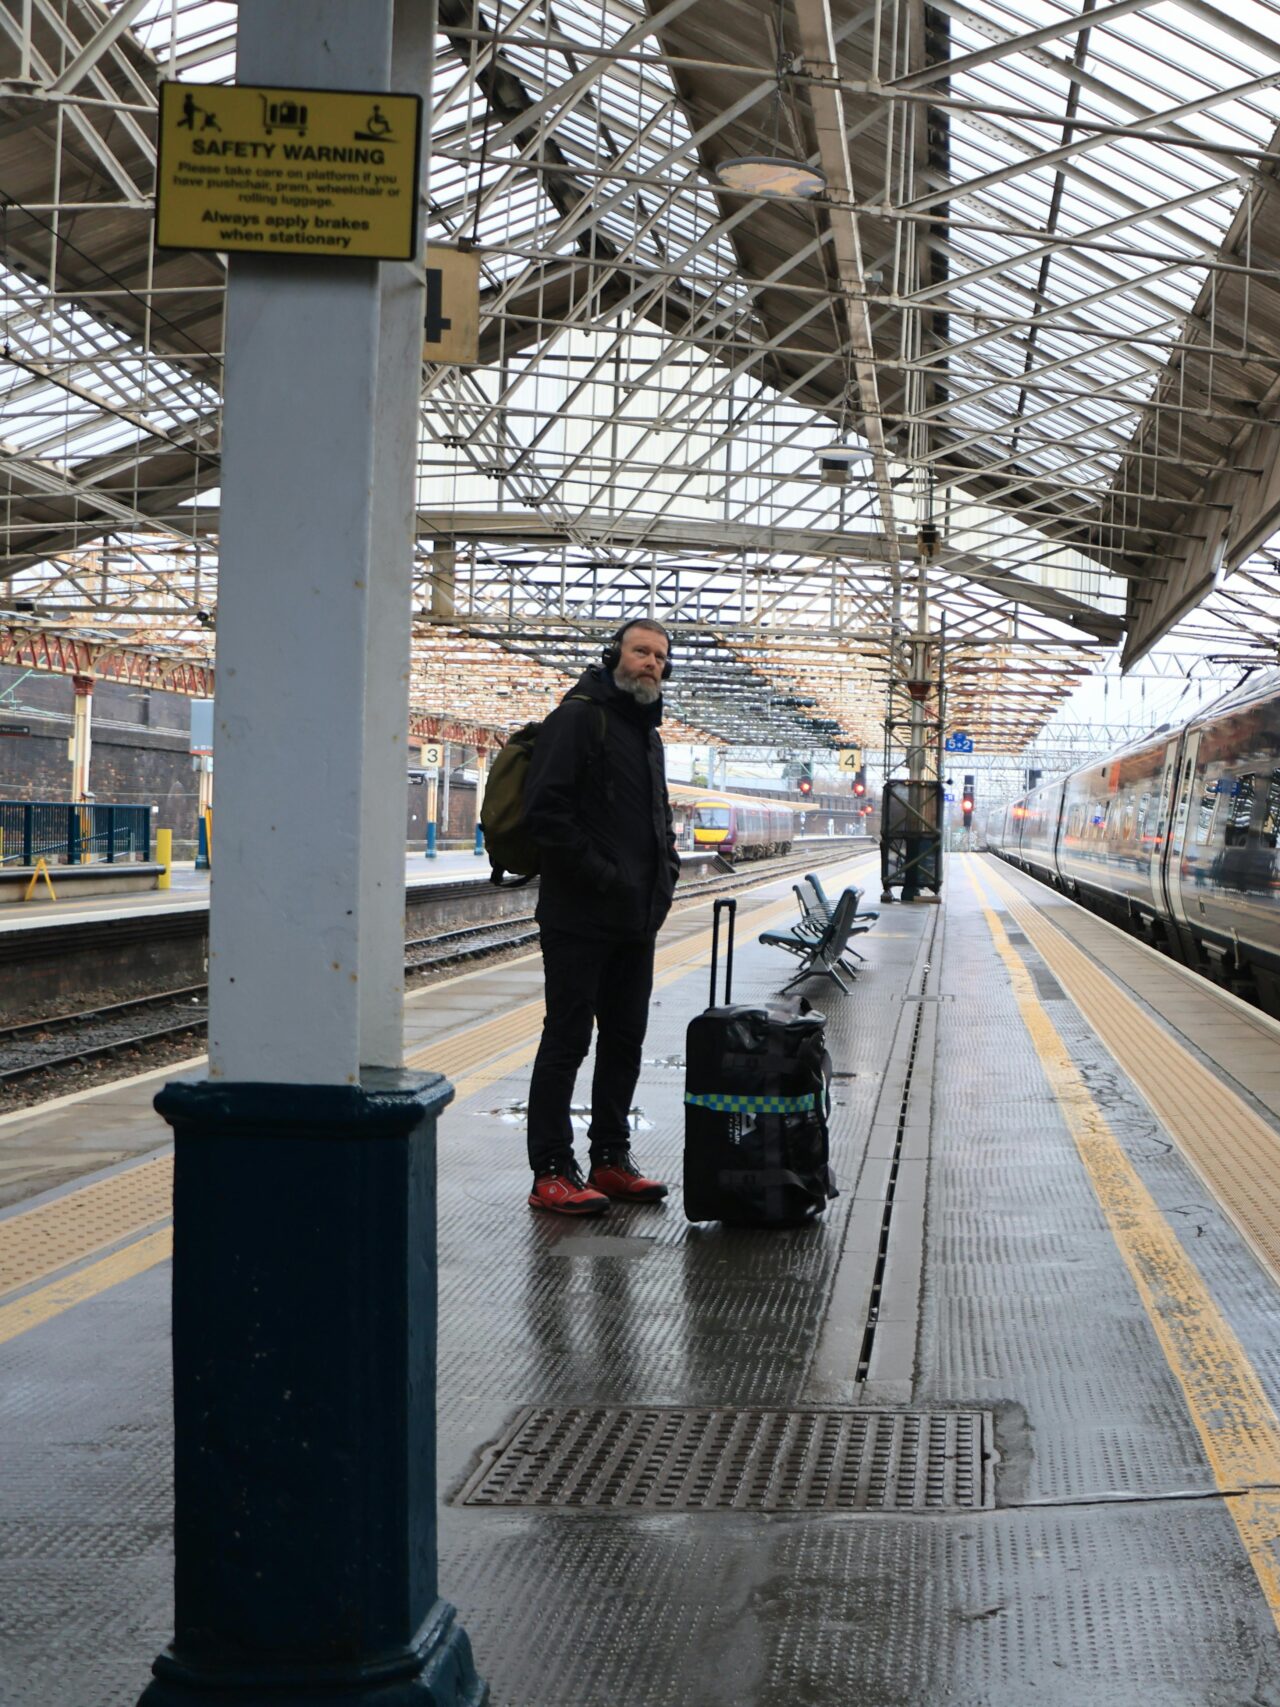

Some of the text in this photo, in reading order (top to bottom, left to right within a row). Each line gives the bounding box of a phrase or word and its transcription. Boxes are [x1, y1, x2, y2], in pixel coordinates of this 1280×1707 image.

[192, 138, 385, 165] SAFETY WARNING
[178, 161, 397, 185] Please take care on platform if you
[173, 175, 204, 186] have
[276, 183, 312, 194] pram,
[316, 184, 382, 197] wheelchair
[387, 188, 400, 197] or
[238, 193, 335, 209] rolling luggage.
[201, 209, 370, 231] Always apply brakes
[219, 228, 352, 249] when stationary
[427, 749, 438, 762] 3
[844, 754, 856, 768] 4
